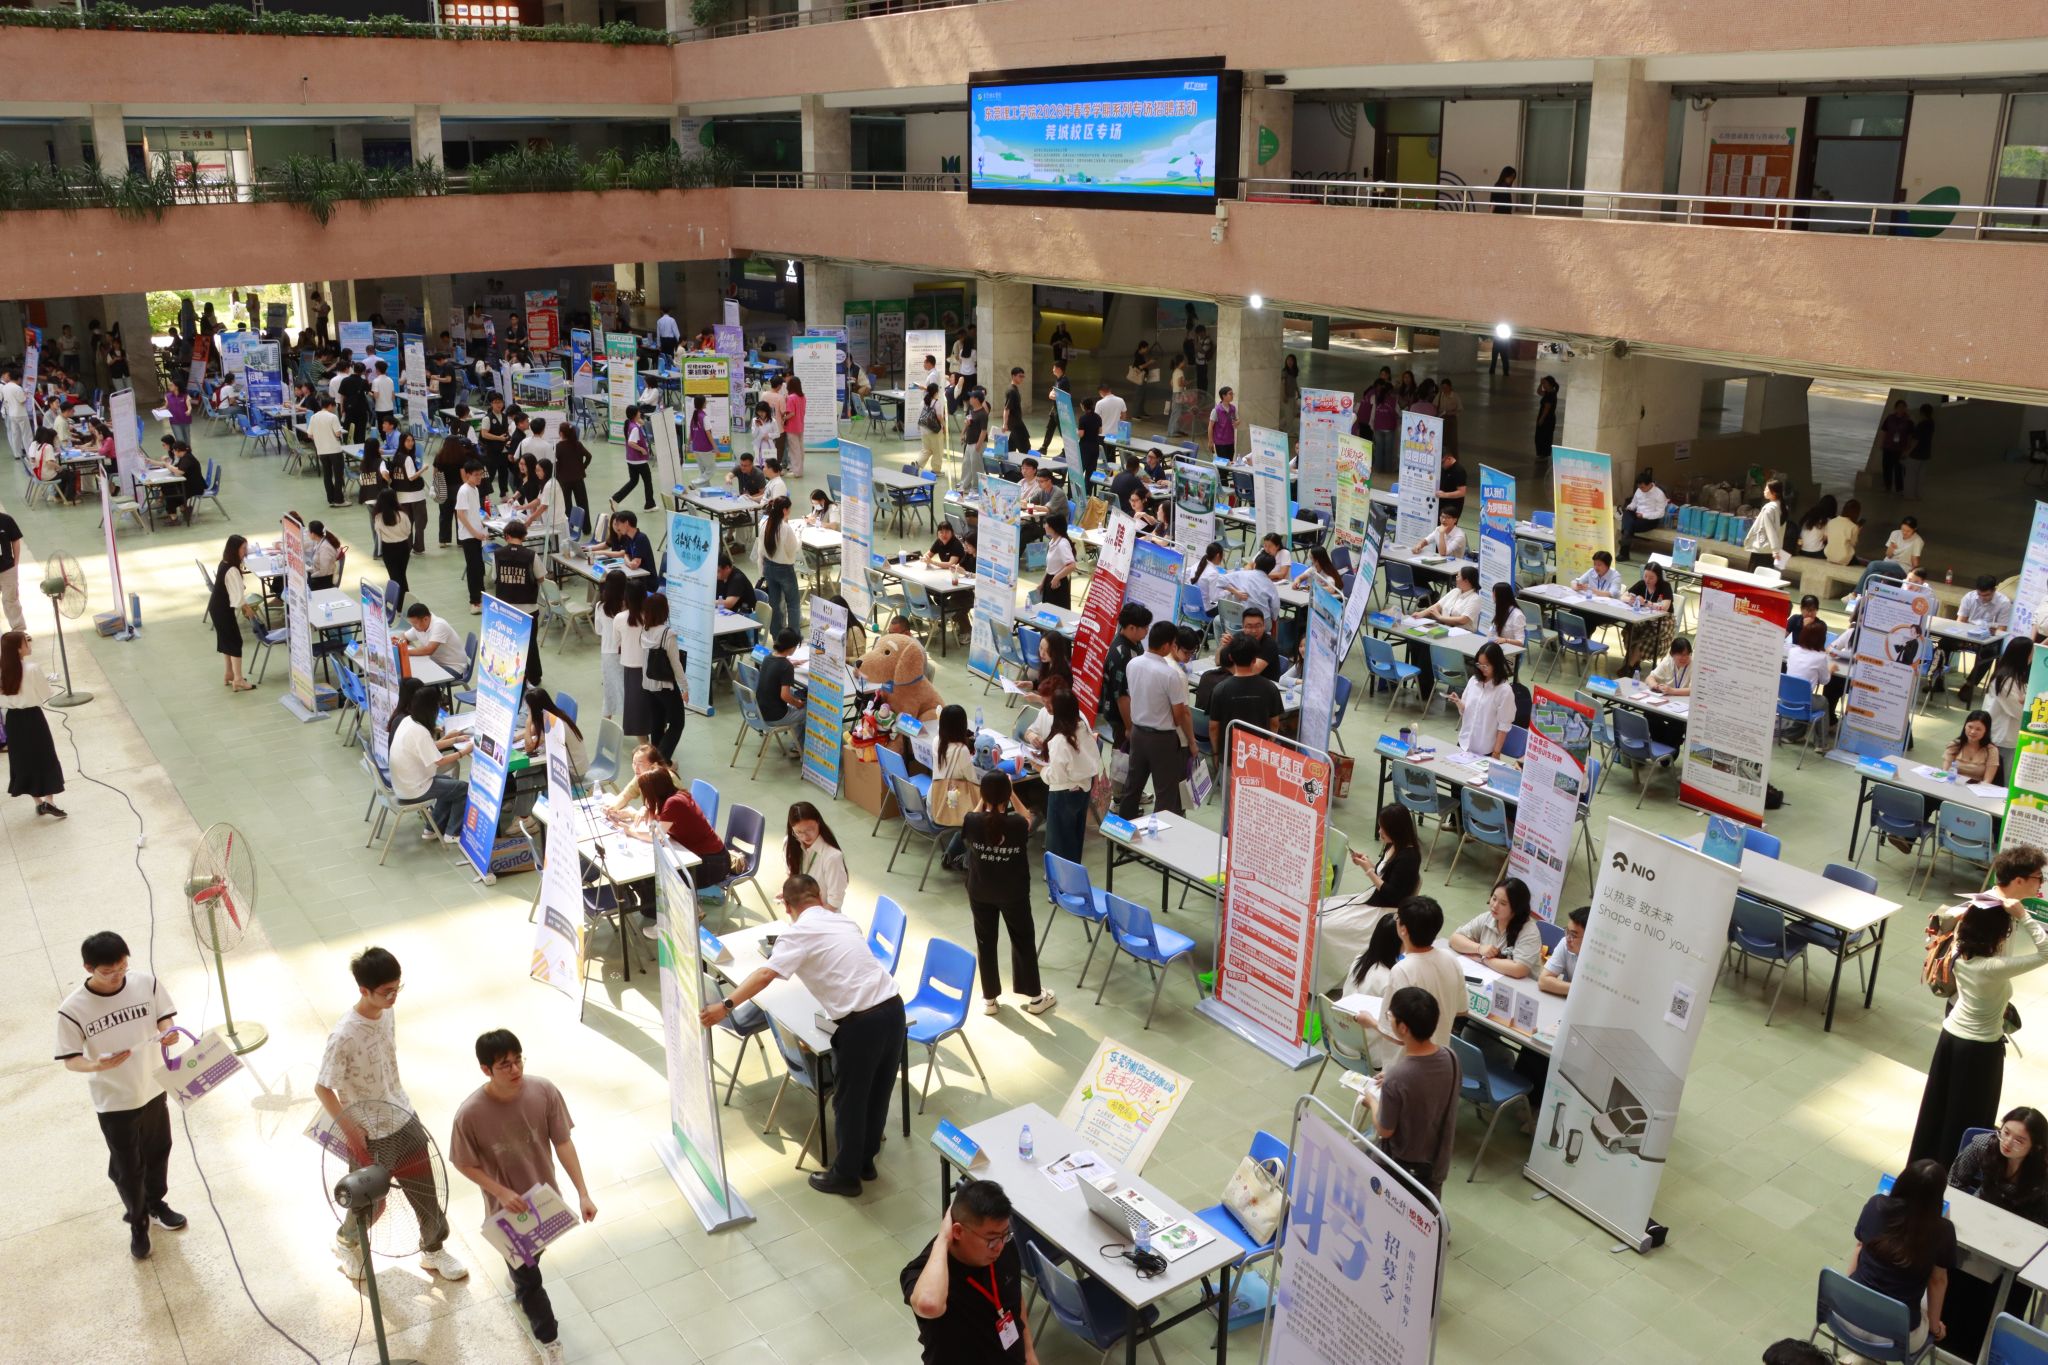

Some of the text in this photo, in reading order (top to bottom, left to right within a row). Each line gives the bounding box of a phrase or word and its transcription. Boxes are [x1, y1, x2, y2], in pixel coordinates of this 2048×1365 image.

[984, 99, 1198, 121] 东莞理工学院2026年春季学期系列专场招聘活动
[179, 129, 214, 140] 三号楼
[1045, 123, 1122, 141] 莞城校区专场
[2010, 808, 2048, 825] 电商运营管
[1631, 862, 1656, 881] NIO
[1603, 885, 1674, 927] 以热爱 致未来
[1598, 903, 1690, 954] Shape a NIO you
[85, 1001, 151, 1037] CREATIVITY
[1104, 1065, 1156, 1103] 春季招聘
[1292, 1133, 1373, 1282] 聘
[1380, 1230, 1401, 1305] 招募令
